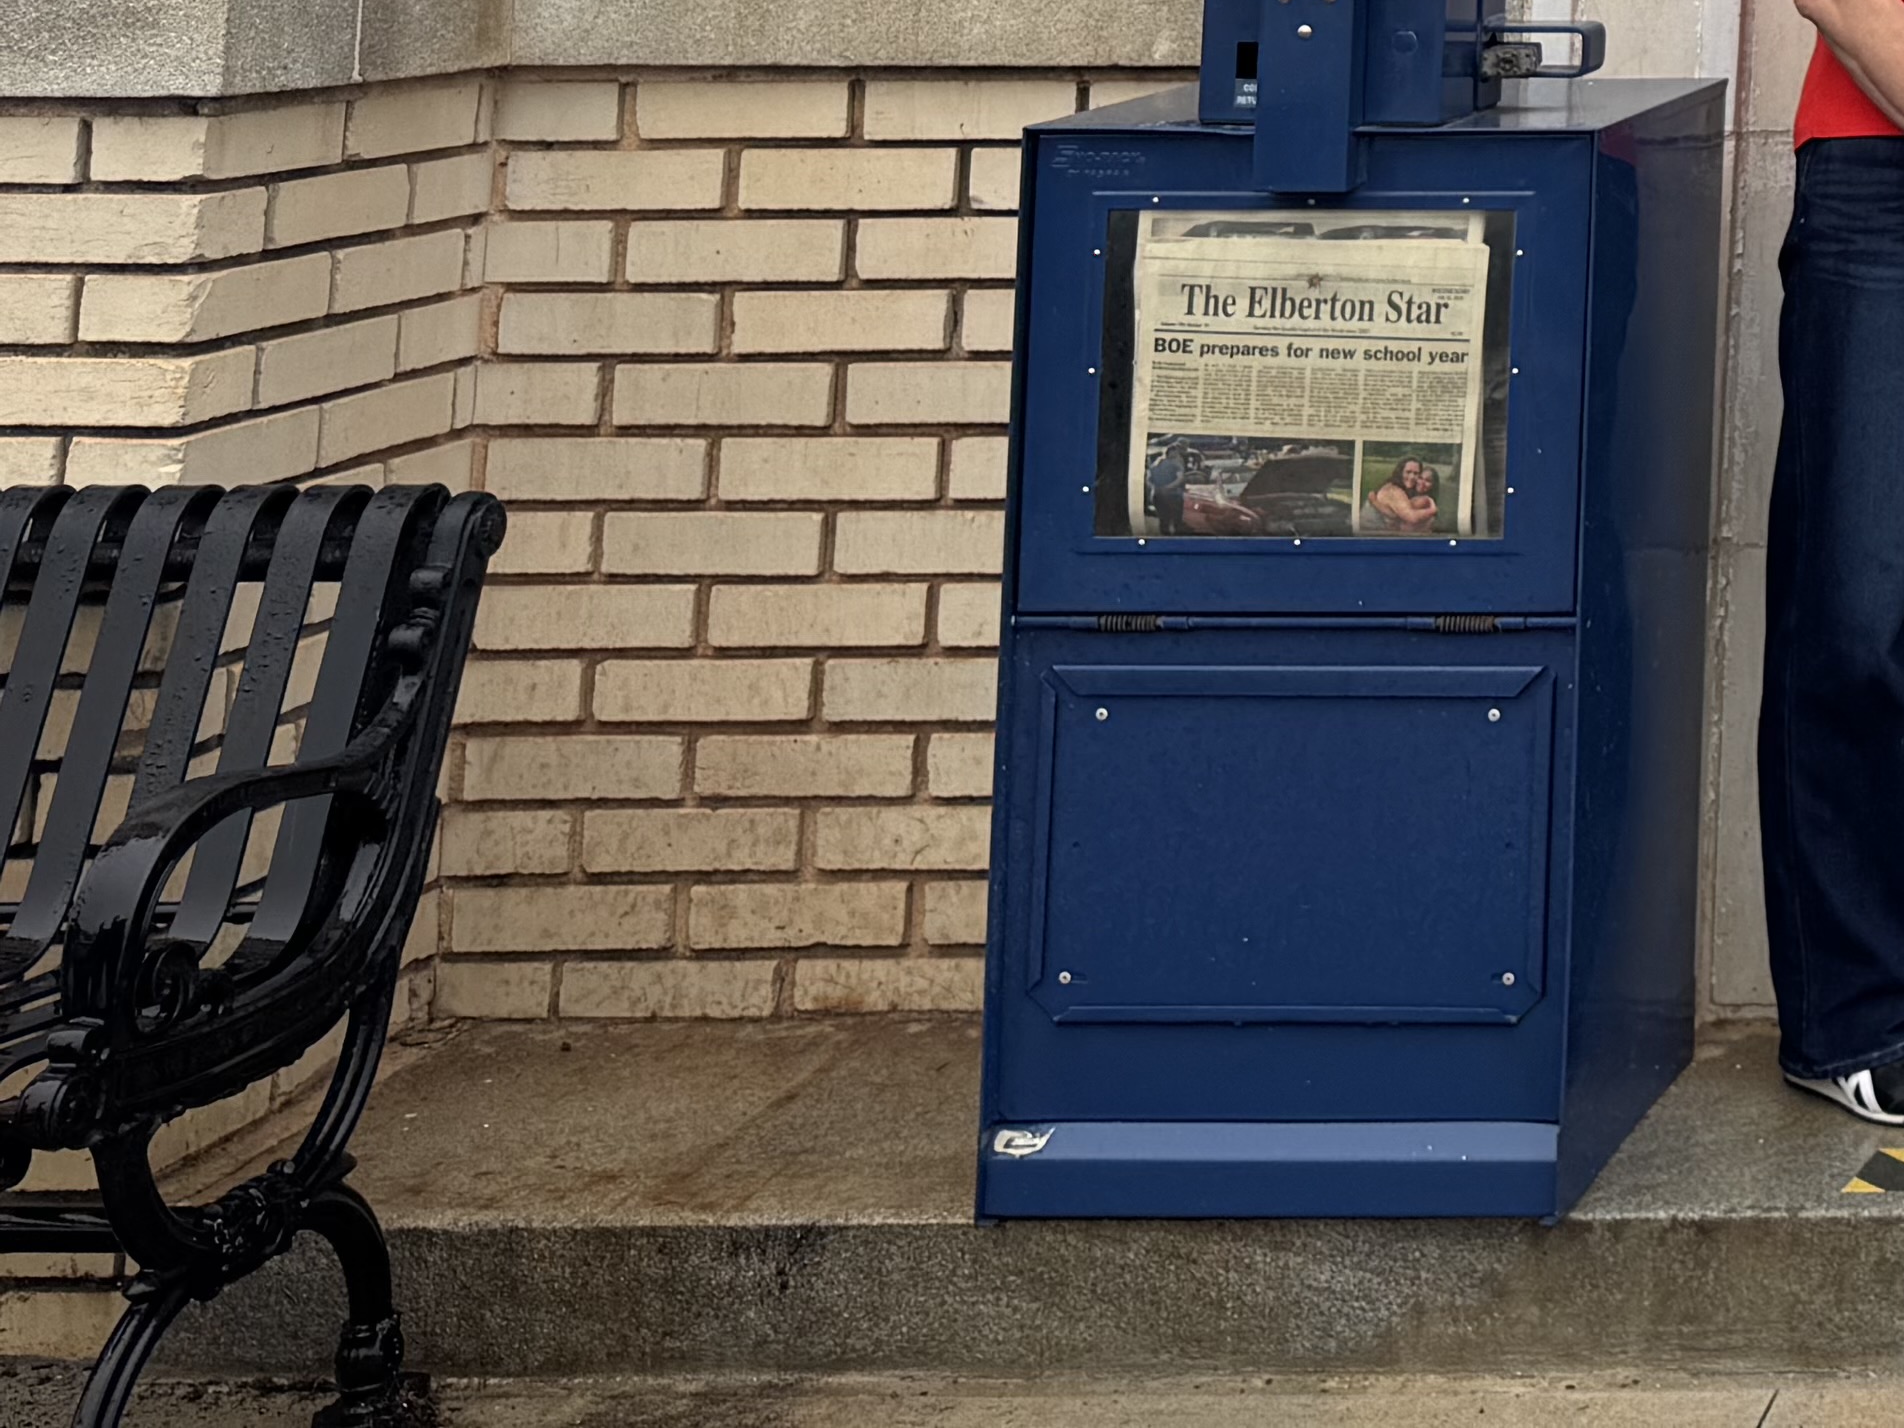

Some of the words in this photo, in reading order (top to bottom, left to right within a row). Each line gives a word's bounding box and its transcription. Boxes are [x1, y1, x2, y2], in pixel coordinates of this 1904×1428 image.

[1181, 283, 1237, 318] The
[1246, 286, 1375, 322] Elberton
[1385, 290, 1449, 324] Star
[1154, 337, 1194, 354] BOE
[1199, 342, 1280, 358] prepares
[1287, 342, 1313, 358] for
[1319, 347, 1357, 359] new
[1363, 345, 1421, 362] school
[1428, 351, 1469, 365] year
